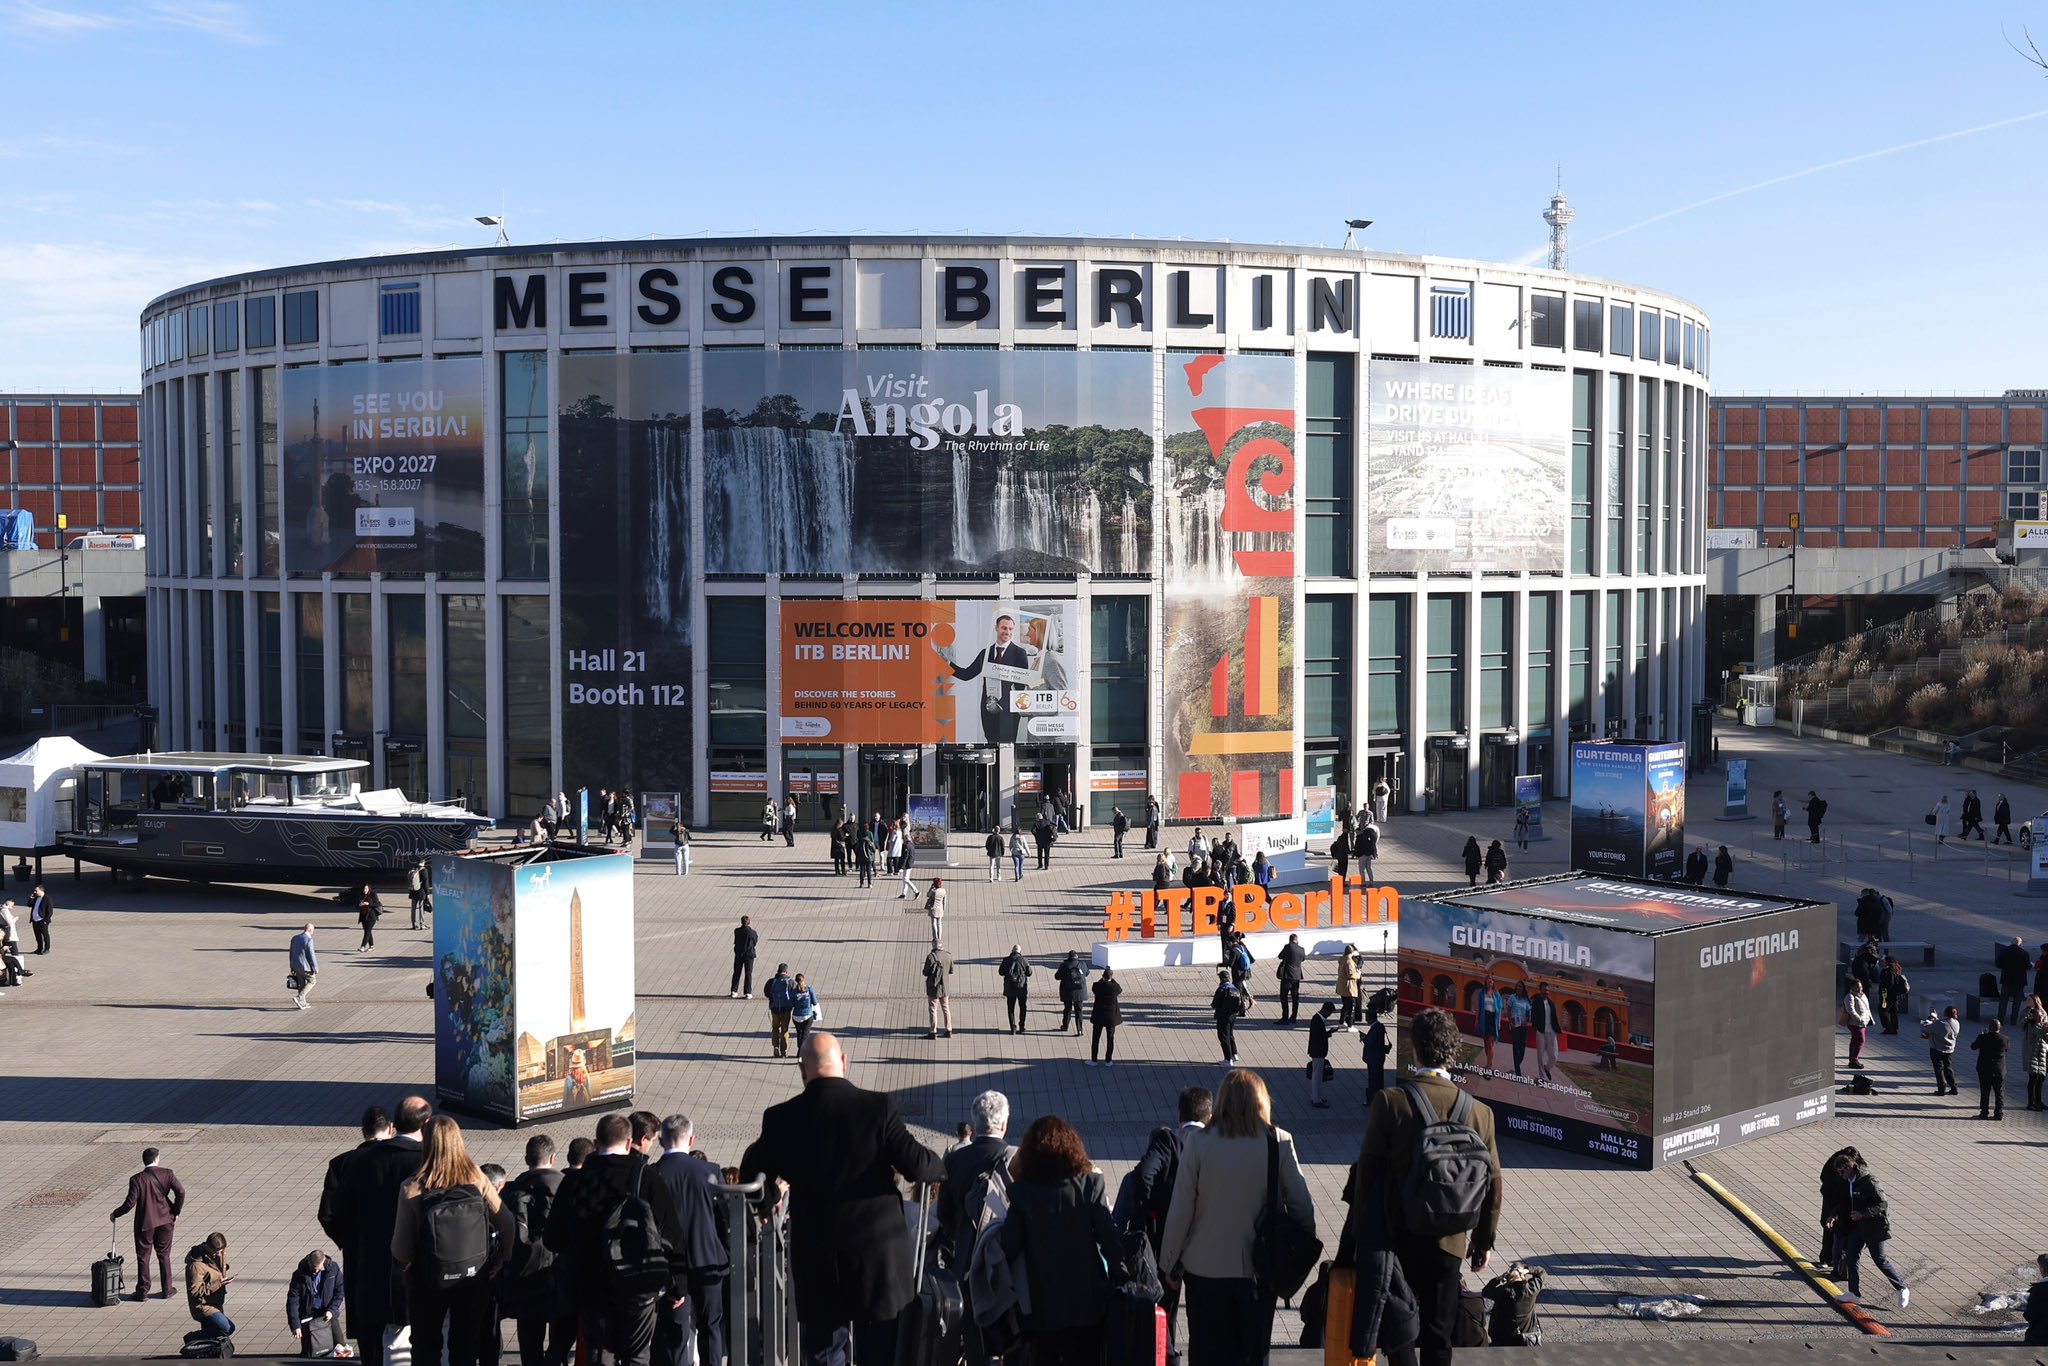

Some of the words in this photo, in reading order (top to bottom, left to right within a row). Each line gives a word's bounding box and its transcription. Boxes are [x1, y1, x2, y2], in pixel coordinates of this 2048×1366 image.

[495, 266, 832, 329] MESSE
[944, 266, 1353, 331] BERLIN
[866, 373, 929, 398] Visit
[1386, 381, 1455, 401] WHERE
[353, 392, 391, 414] SEE
[397, 390, 444, 412] YOU
[831, 388, 1025, 450] Angola
[1386, 404, 1443, 423] DRIVE
[353, 419, 373, 439] IN
[380, 415, 467, 438] SERBIA!
[1387, 430, 1416, 442] VISIT
[1417, 431, 1432, 442] US
[1434, 432, 1447, 443] AT
[944, 440, 967, 451] The
[968, 440, 1014, 453] Rhythm
[1015, 440, 1028, 451] of
[1029, 440, 1050, 451] Life
[354, 456, 395, 473] EXPO
[398, 455, 437, 472] 2027
[380, 479, 421, 491] 15.8.2027
[794, 622, 895, 638] WELCOME
[902, 622, 927, 638] TO
[569, 649, 616, 671] Hall
[623, 651, 646, 671] 21
[795, 644, 825, 660] ITB
[832, 644, 910, 660] BERLIN!
[569, 683, 644, 705] Booth
[651, 685, 685, 706] 112
[794, 690, 839, 698] DISCOVER
[841, 690, 858, 698] THE
[860, 690, 896, 698] STORIES
[1036, 693, 1053, 702] ITB
[794, 701, 828, 709] BEHIND
[830, 701, 841, 709] 60
[843, 701, 872, 709] YEARS
[875, 701, 887, 709] OF
[889, 701, 926, 709] LEGACY.
[1576, 749, 1642, 763] GUATEMALA
[144, 820, 153, 828] SEA
[154, 821, 166, 829] LOFT
[1265, 834, 1298, 850] Angola
[1589, 851, 1602, 859] YOUR
[1603, 852, 1625, 861] STORIES
[434, 883, 464, 898] VIELFALT
[1587, 882, 1763, 909] GUATEMALA
[1452, 925, 1591, 967] GUATEMALA
[1700, 929, 1799, 969] GUATEMALA
[1453, 1074, 1467, 1084] 206
[1454, 1062, 1464, 1070] La
[1464, 1064, 1493, 1077] Antigua
[1494, 1070, 1536, 1088] Guatemala,
[1538, 1078, 1592, 1099] Sacatepéquez
[1803, 1097, 1820, 1109] HALL
[1820, 1095, 1828, 1104] 22
[1662, 1112, 1674, 1124] Hall
[1674, 1111, 1682, 1121] 22
[1683, 1107, 1700, 1119] Stand
[1700, 1104, 1712, 1115] 206
[1795, 1109, 1815, 1121] STAND
[1816, 1104, 1828, 1115] 206
[1507, 1117, 1529, 1131] YOUR
[1529, 1122, 1563, 1141] STORIES
[1741, 1120, 1757, 1137] YOUR
[1757, 1114, 1780, 1131] STORIES
[1600, 1132, 1625, 1147] HALL
[1626, 1138, 1638, 1149] 22
[1663, 1123, 1720, 1150] GUATEMALA
[1589, 1139, 1619, 1155] STAND
[1621, 1148, 1638, 1160] 206
